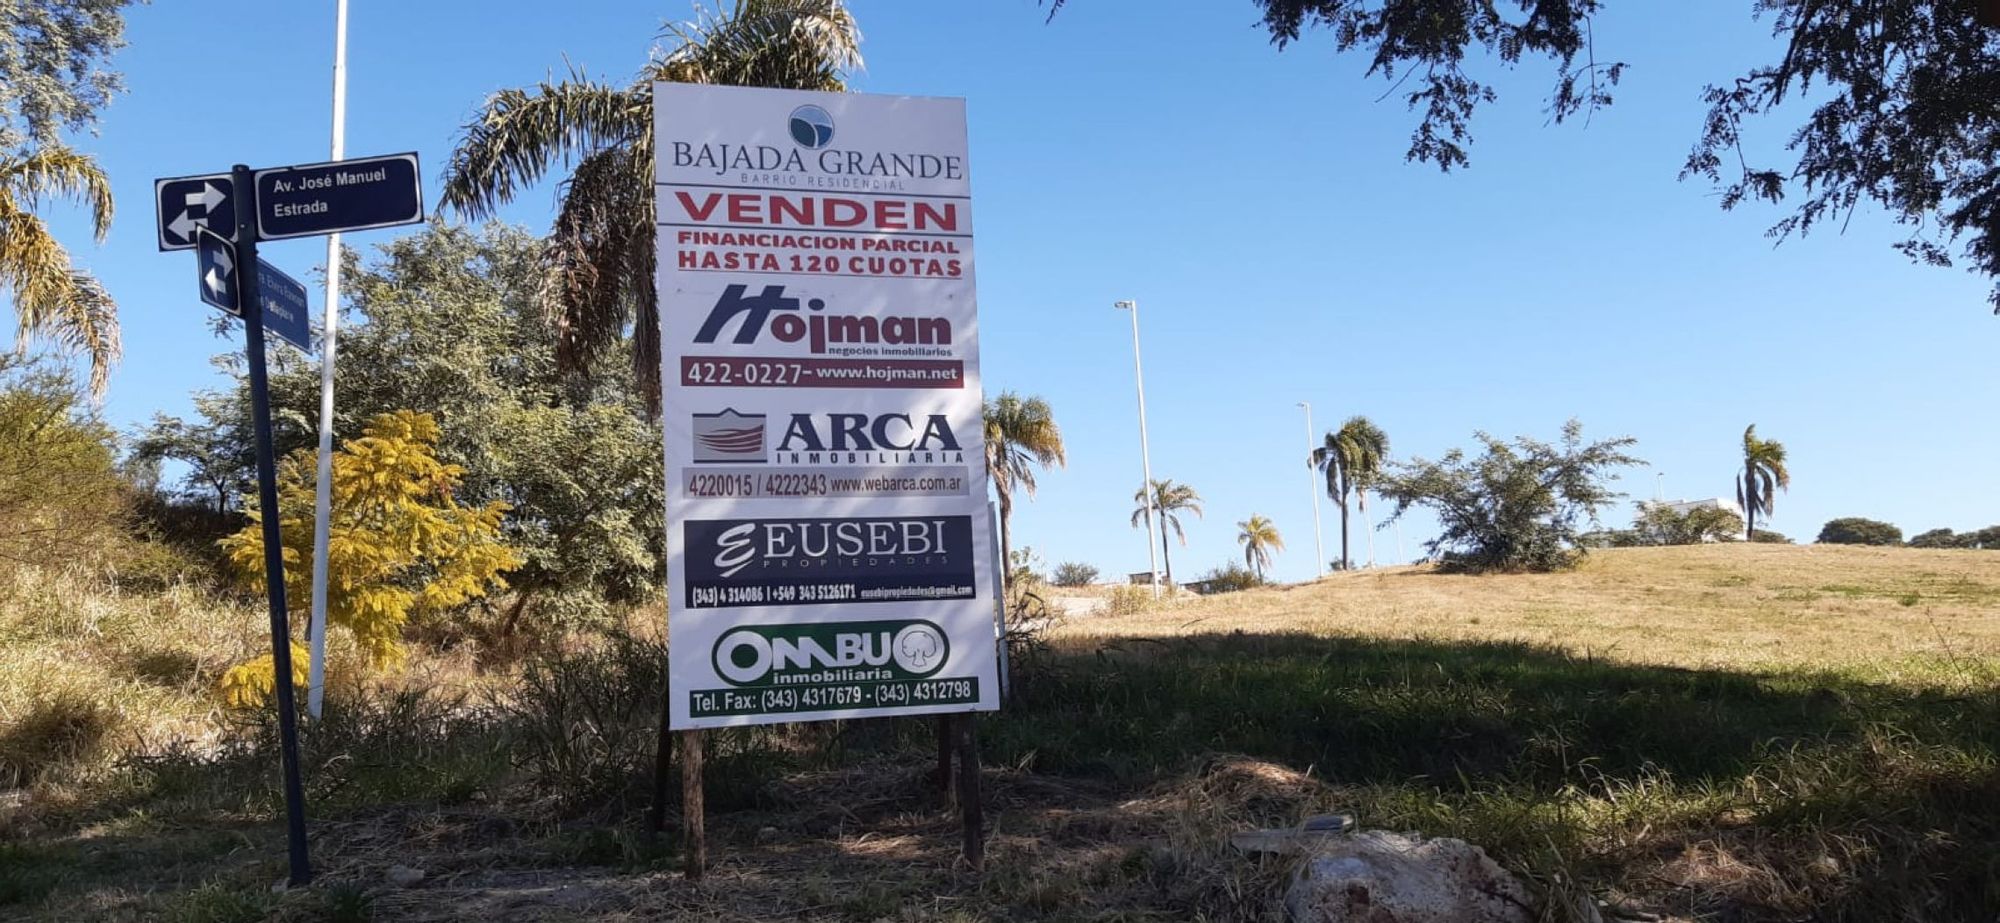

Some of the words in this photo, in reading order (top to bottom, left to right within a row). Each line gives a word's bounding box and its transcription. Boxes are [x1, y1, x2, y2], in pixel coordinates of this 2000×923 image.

[672, 141, 808, 175] BAJADA
[819, 150, 962, 180] GRANDE
[273, 179, 295, 193] Av.
[299, 173, 332, 190] José
[336, 167, 386, 186] Manuel
[741, 174, 797, 186] BARRIO
[808, 176, 905, 190] RESIDENCIAL
[274, 200, 328, 217] Estrada
[674, 192, 957, 232] VENDEN
[678, 231, 855, 250] FINANCIACION
[862, 238, 960, 254] PARCIAL
[678, 251, 780, 272] HASTA
[790, 255, 840, 273] 120
[849, 257, 962, 277] CUOTAS
[693, 284, 952, 354] Hojman
[828, 347, 878, 356] negocios
[882, 346, 952, 356] inmobiliarios
[817, 366, 958, 381] www.hojman.net
[776, 413, 962, 451] ARCA
[777, 452, 963, 464] INMOBILIARIA
[689, 474, 752, 496] 4220015
[766, 474, 826, 495] 4222343
[831, 476, 961, 491] www.webarca.com.ar
[764, 520, 946, 558] EUSEBI
[764, 556, 948, 568] PROPIEDADES
[693, 586, 718, 605] (343)
[720, 588, 727, 602] 4
[727, 585, 763, 603] 314086
[772, 586, 795, 602] +549
[799, 586, 816, 601] 343
[817, 584, 856, 599] 5126171
[773, 668, 893, 684] inmobiliaria
[694, 692, 720, 712] Tel.
[725, 691, 756, 710] Fax:
[761, 688, 798, 712] (343)
[802, 686, 862, 707] 4317679
[875, 684, 909, 706] (343)
[913, 681, 971, 701] 4312798
